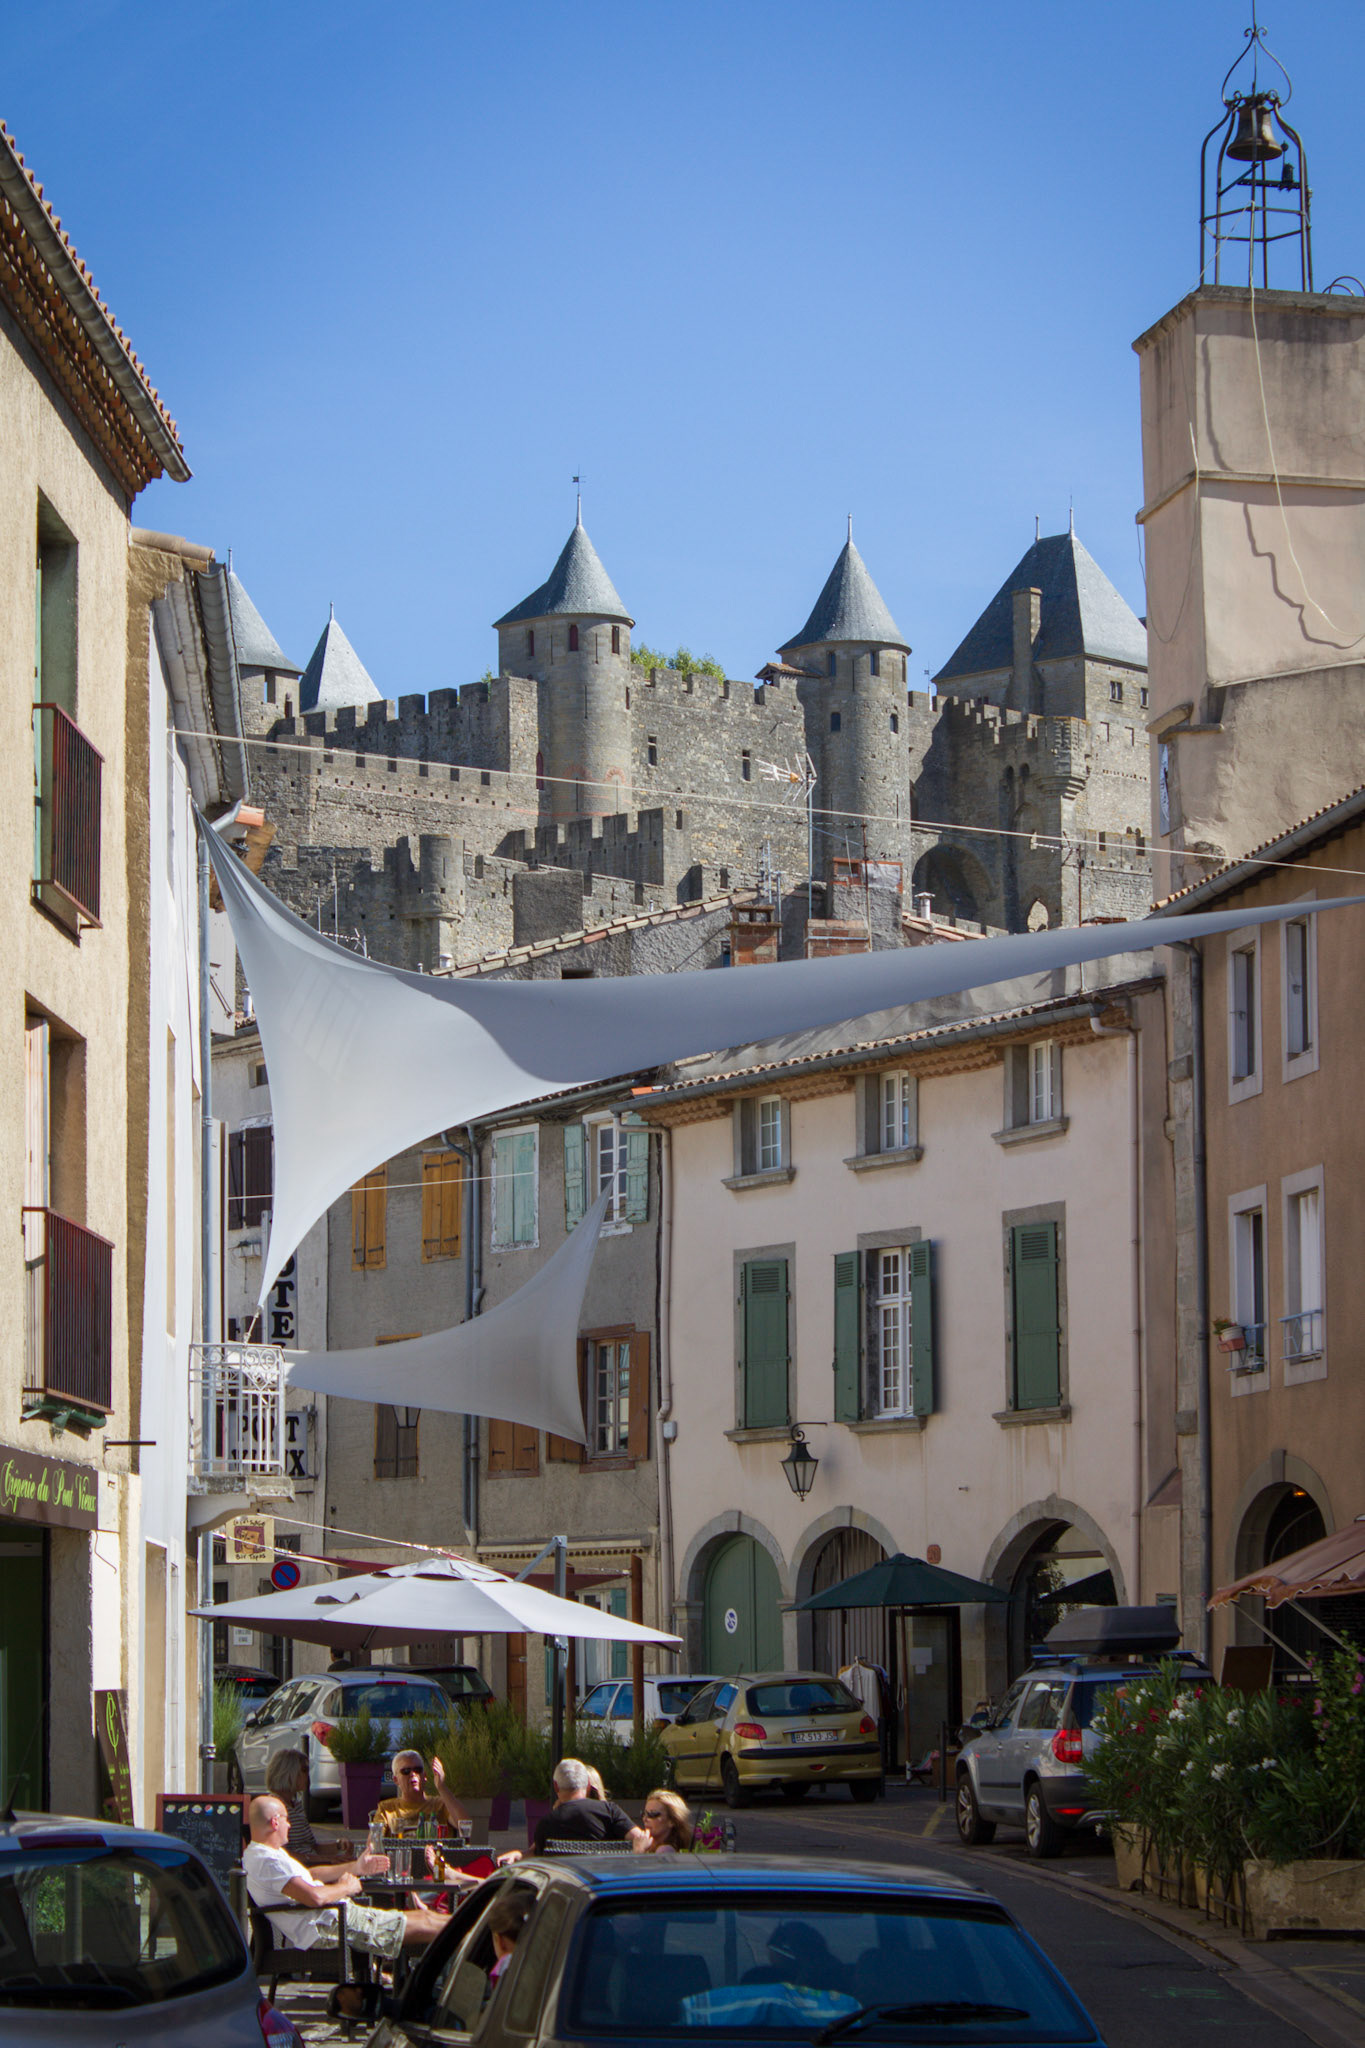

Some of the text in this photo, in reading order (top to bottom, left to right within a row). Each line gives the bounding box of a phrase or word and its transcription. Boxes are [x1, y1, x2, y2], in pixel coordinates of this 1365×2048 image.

[237, 1415, 300, 1442] POT
[37, 1467, 49, 1502] du
[52, 1468, 74, 1507] Pont
[75, 1474, 96, 1512] Vieux
